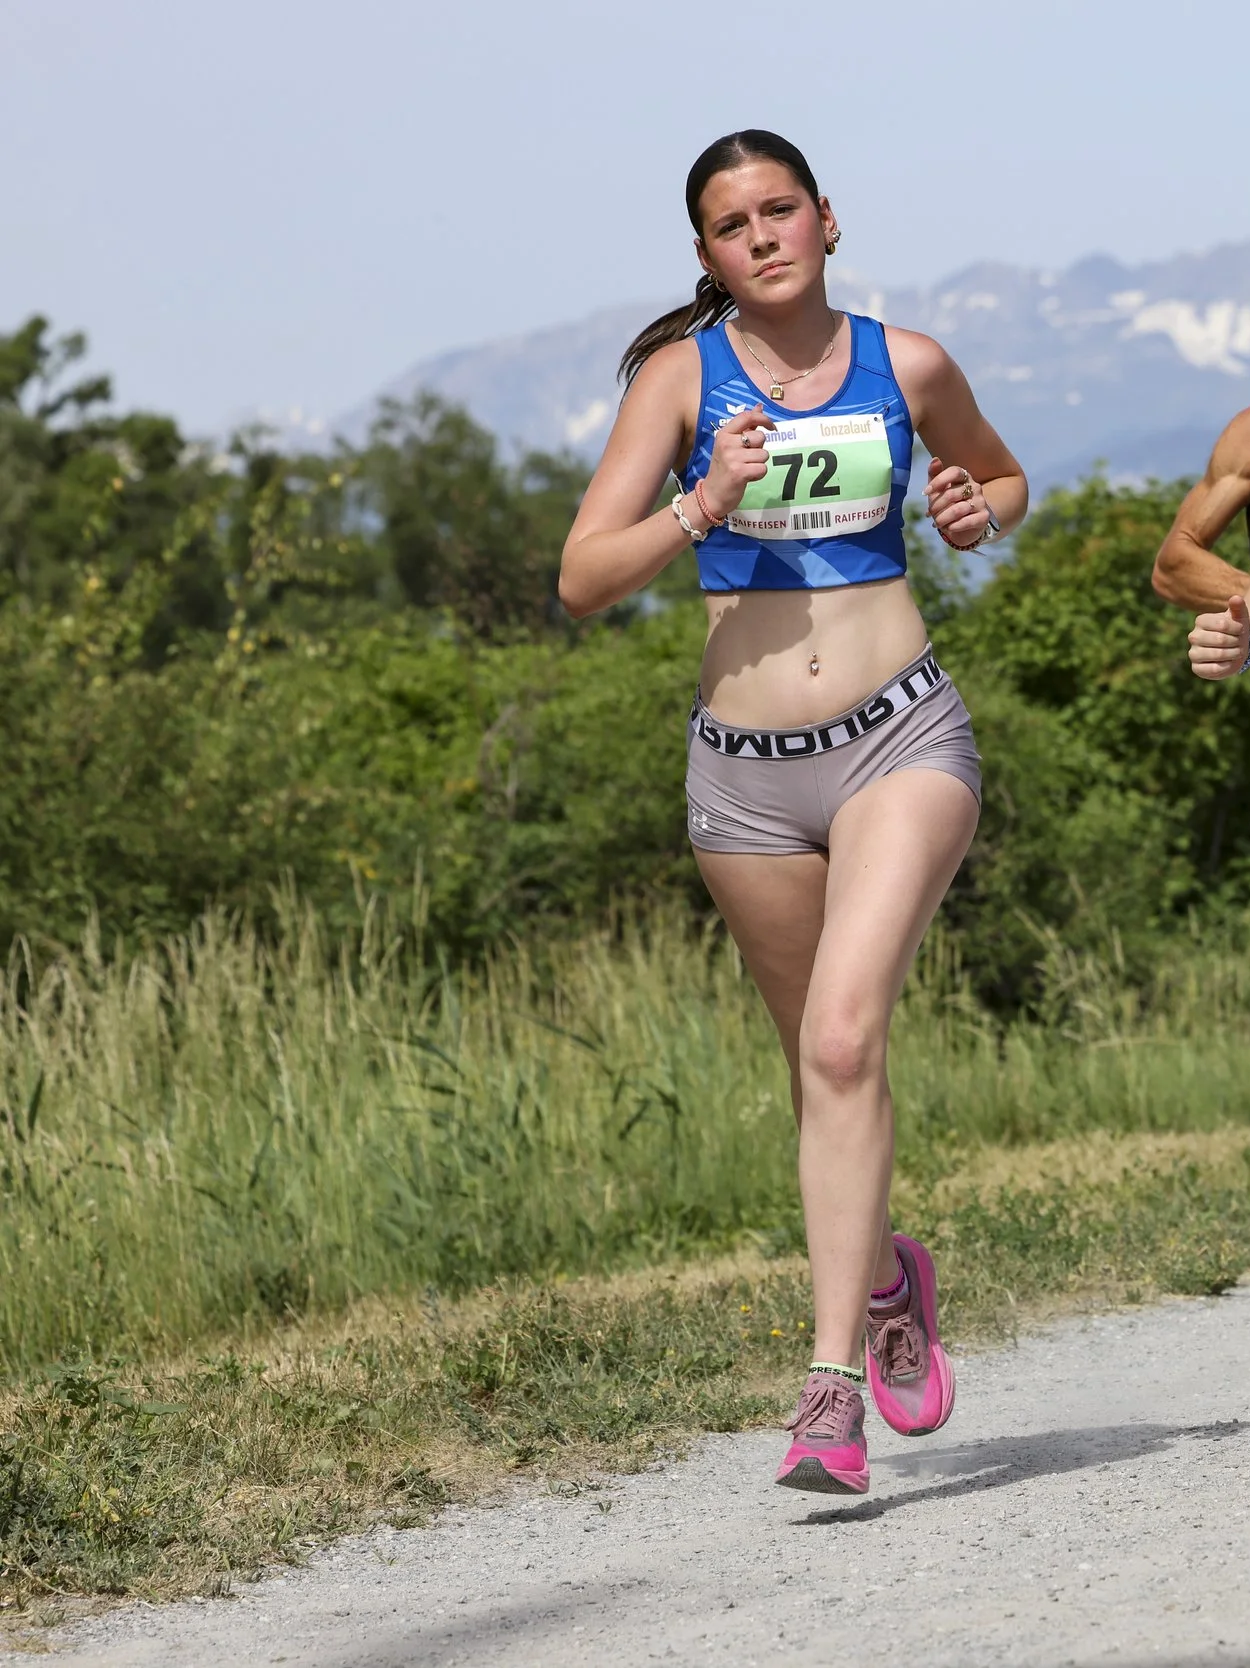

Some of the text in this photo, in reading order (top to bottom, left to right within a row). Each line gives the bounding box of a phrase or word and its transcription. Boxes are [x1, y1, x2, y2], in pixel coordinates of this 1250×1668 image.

[765, 428, 797, 443] ampel
[820, 419, 872, 438] lonzalauf
[772, 450, 841, 501] 72
[731, 516, 787, 530] RAIFFEISEN
[834, 505, 886, 525] RAIFFEISEN
